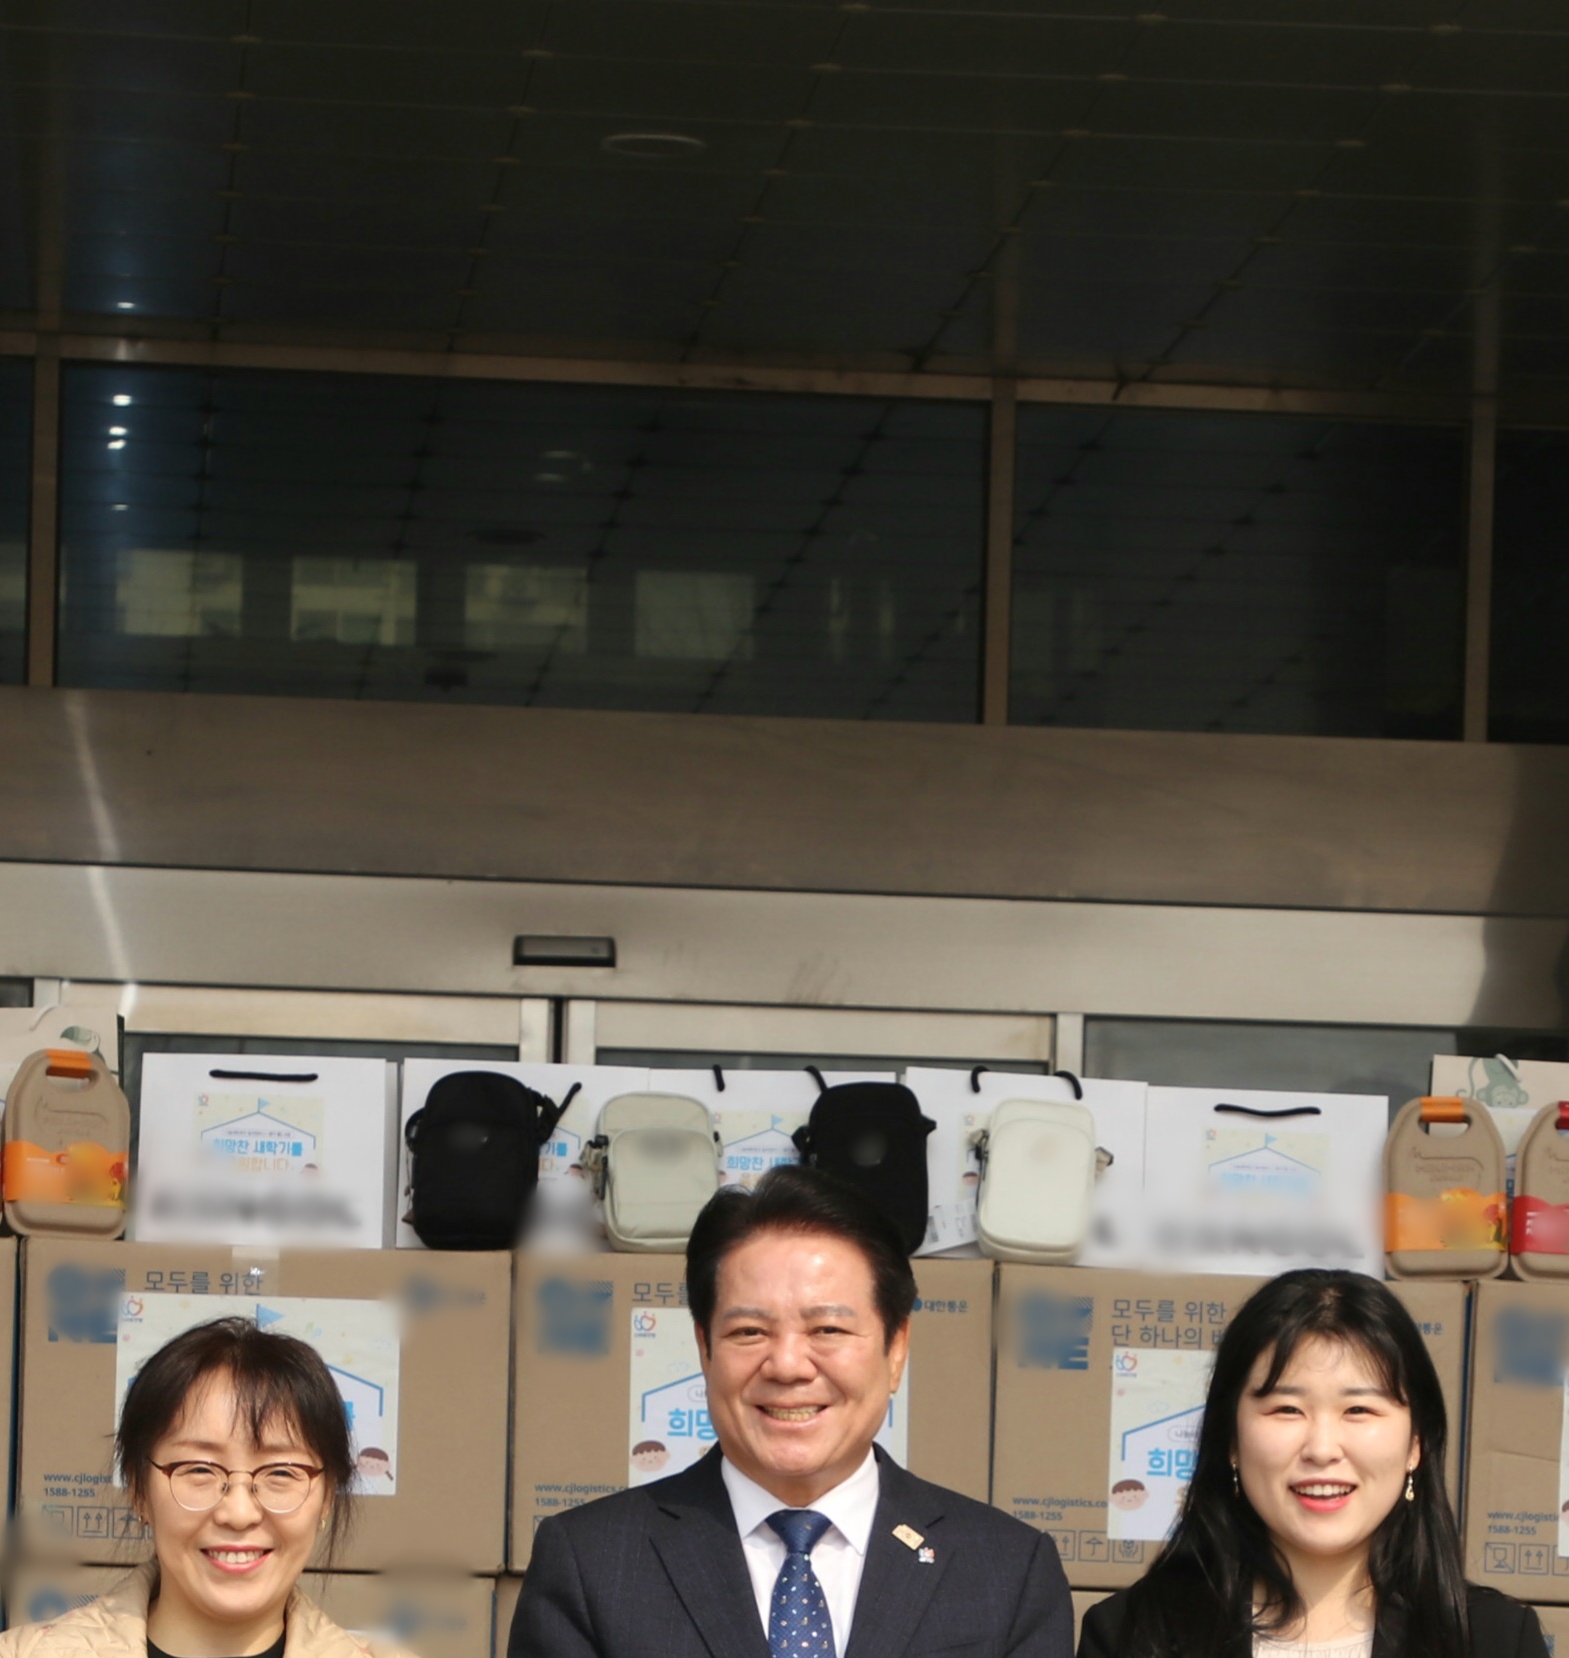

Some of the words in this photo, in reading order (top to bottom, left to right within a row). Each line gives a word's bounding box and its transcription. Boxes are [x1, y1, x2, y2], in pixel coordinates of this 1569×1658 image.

[144, 1270, 211, 1293] 모두를
[220, 1271, 265, 1295] 위한
[1111, 1298, 1177, 1322] 모두를
[1184, 1300, 1227, 1325] 위한
[1111, 1324, 1131, 1347] 단
[1139, 1325, 1204, 1350] 하나의
[667, 1407, 717, 1440] 희망
[1146, 1446, 1198, 1480] 희망
[43, 1472, 113, 1486] www.cjlogist
[43, 1486, 96, 1498] 1588-1255
[1012, 1496, 1108, 1509] www.cjlogistics.co
[1487, 1511, 1560, 1524] www.cjlogistic
[1487, 1524, 1537, 1536] 1588-1255
